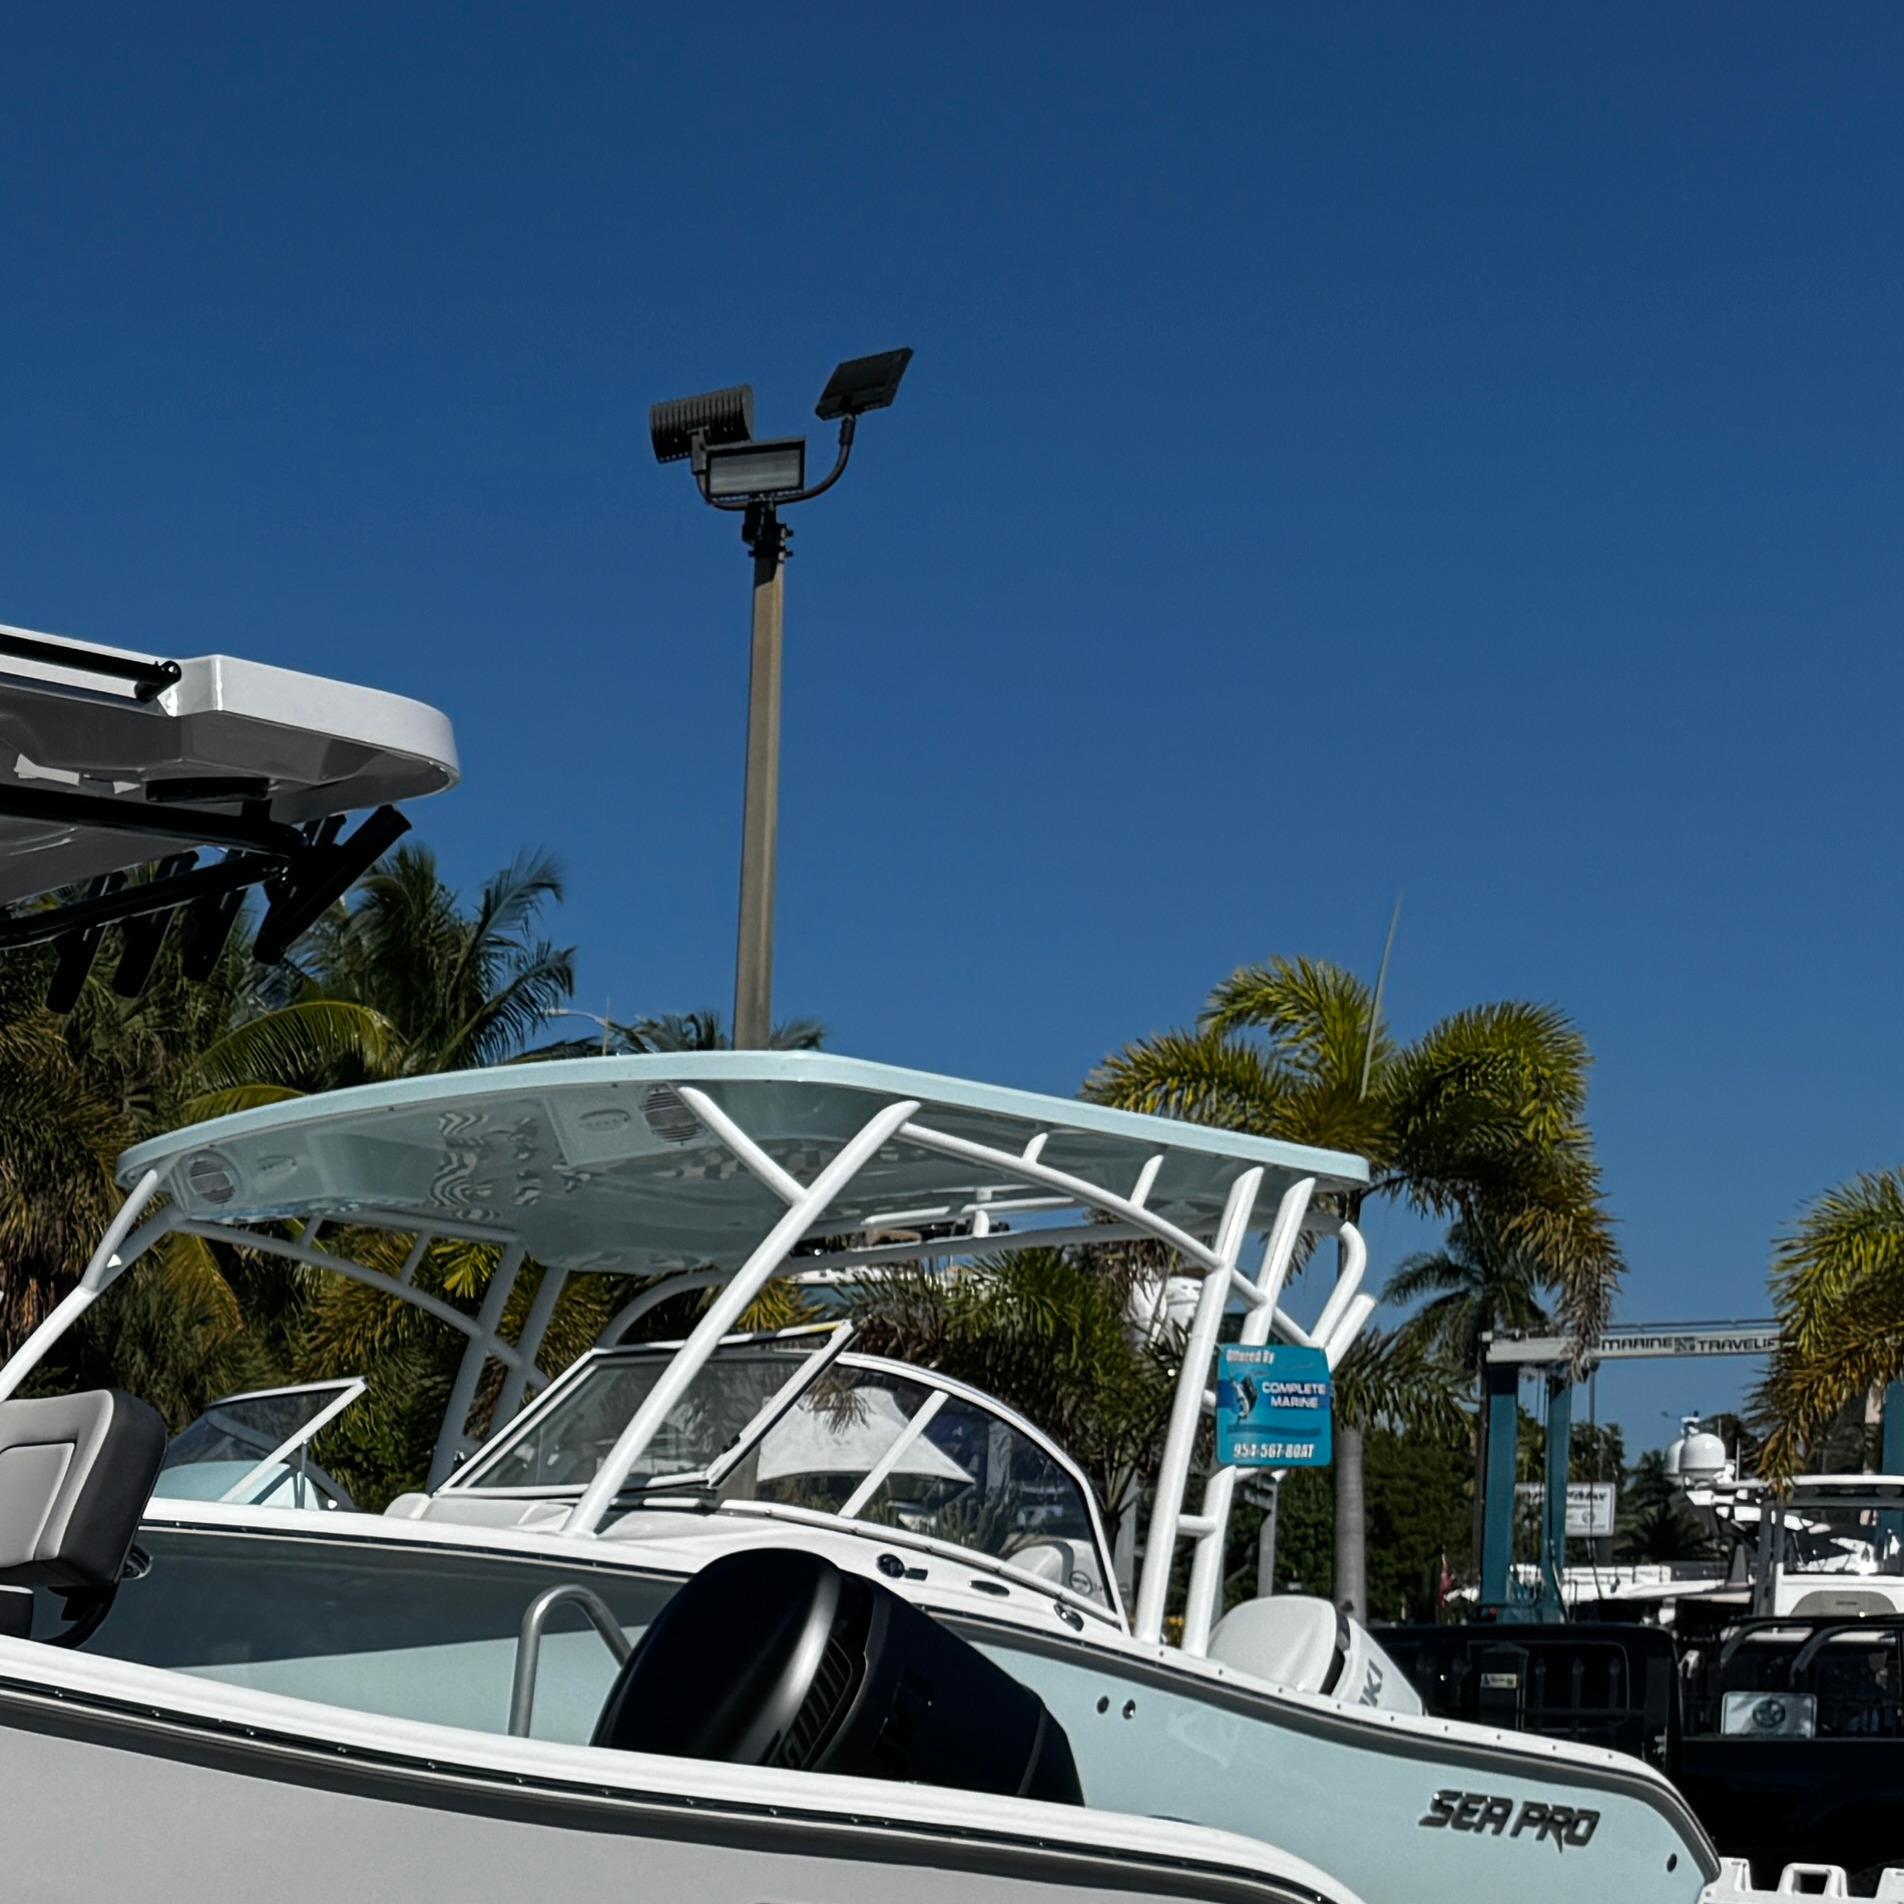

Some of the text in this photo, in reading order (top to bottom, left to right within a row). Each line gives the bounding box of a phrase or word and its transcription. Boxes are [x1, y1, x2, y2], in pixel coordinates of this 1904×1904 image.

[1697, 1337, 1777, 1352] TRAVELIF
[1262, 1382, 1327, 1395] COMPLETE
[1271, 1397, 1318, 1409] MARINE
[1418, 1789, 1601, 1854] SEA PRO
